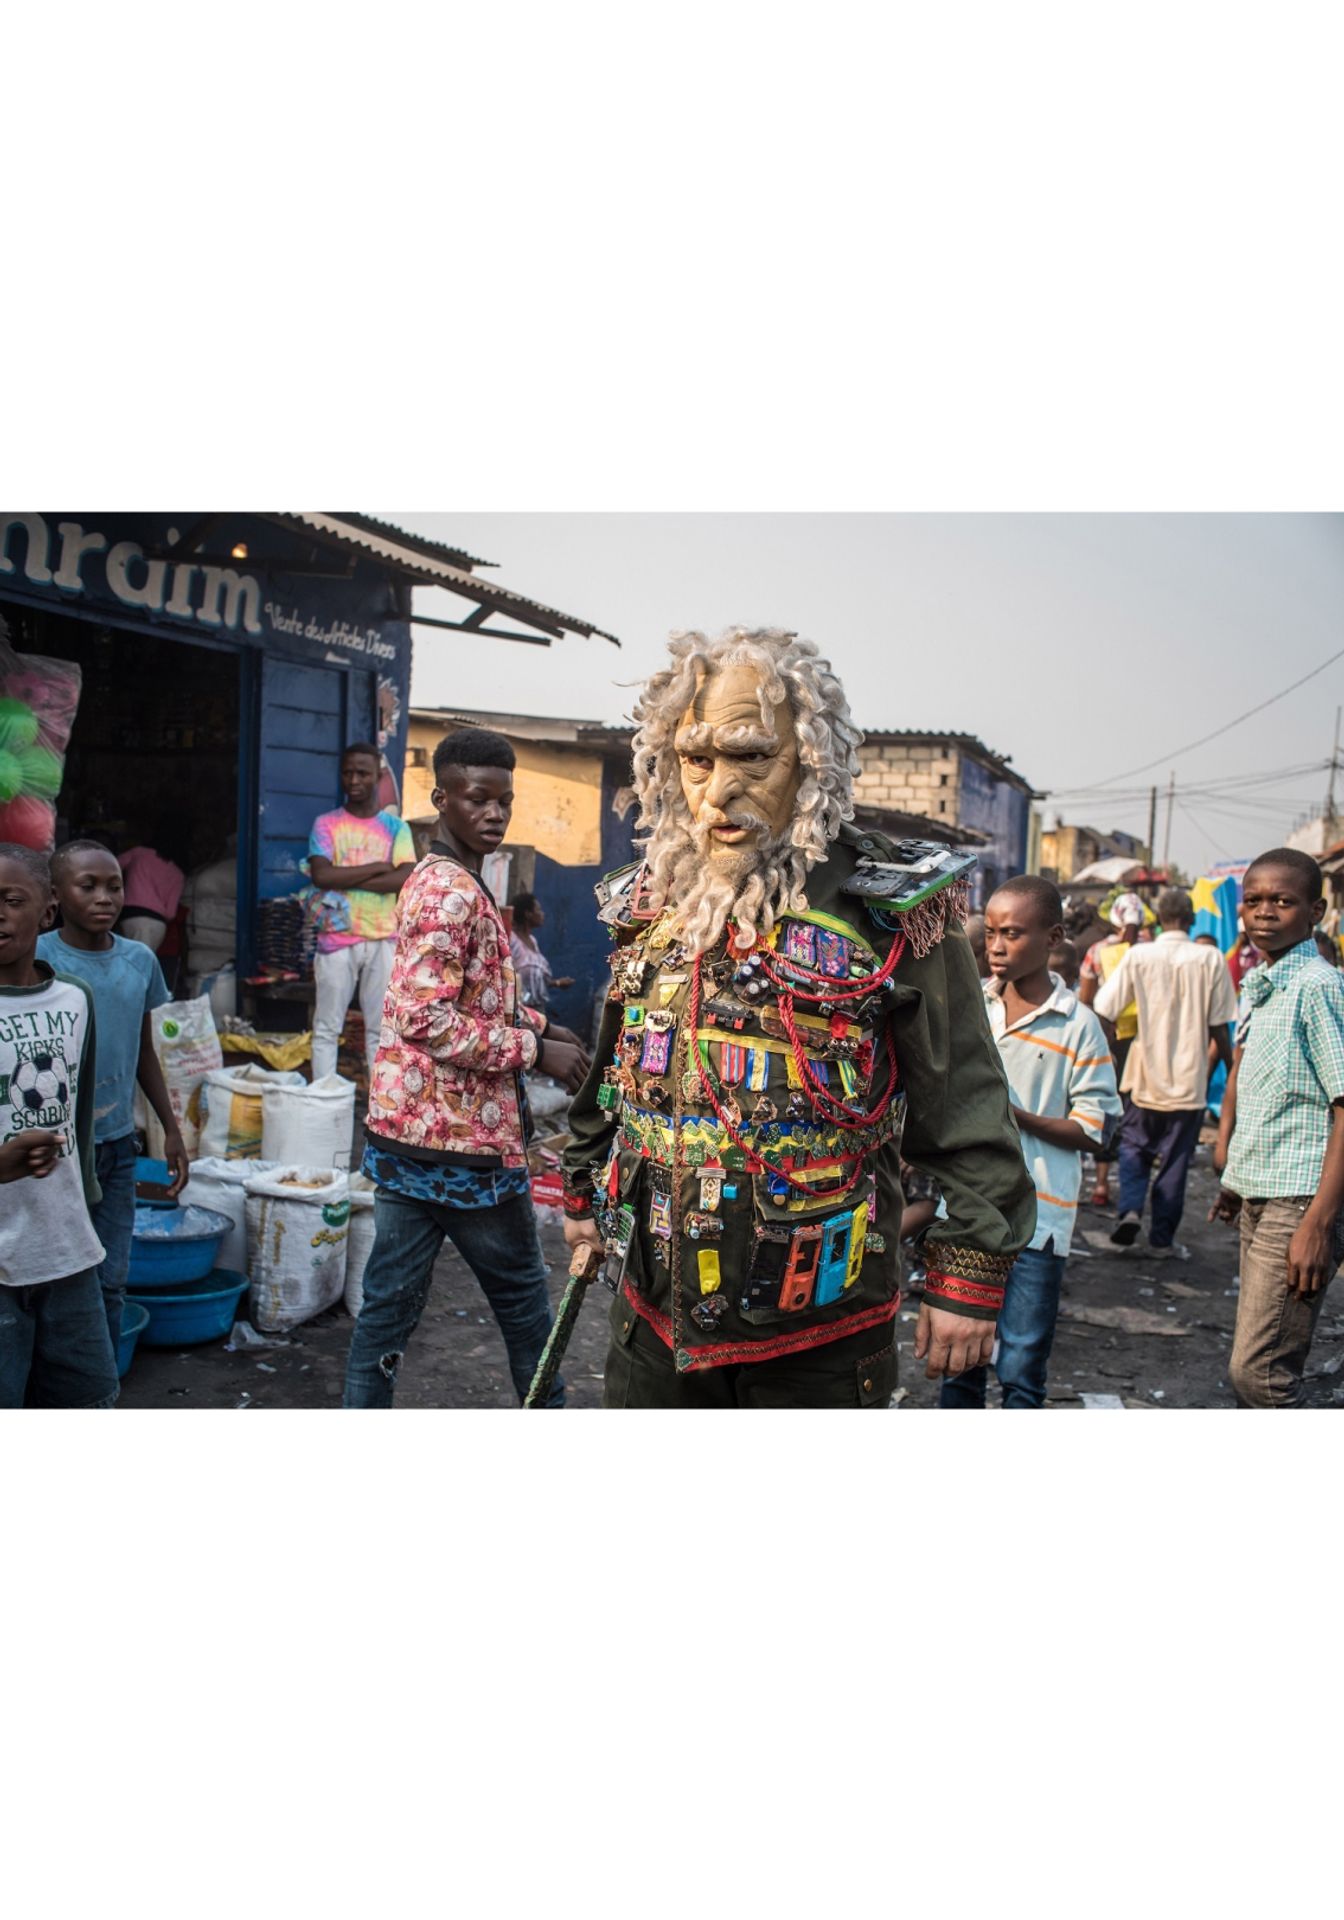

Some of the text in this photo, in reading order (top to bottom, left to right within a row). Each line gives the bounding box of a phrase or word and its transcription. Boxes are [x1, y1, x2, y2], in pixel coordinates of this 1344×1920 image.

[264, 602, 303, 636] Vente
[304, 616, 325, 642] des
[324, 620, 365, 651] Articles
[365, 629, 396, 660] Divers
[0, 1011, 79, 1043] GET MY
[13, 1037, 65, 1063] KICKS
